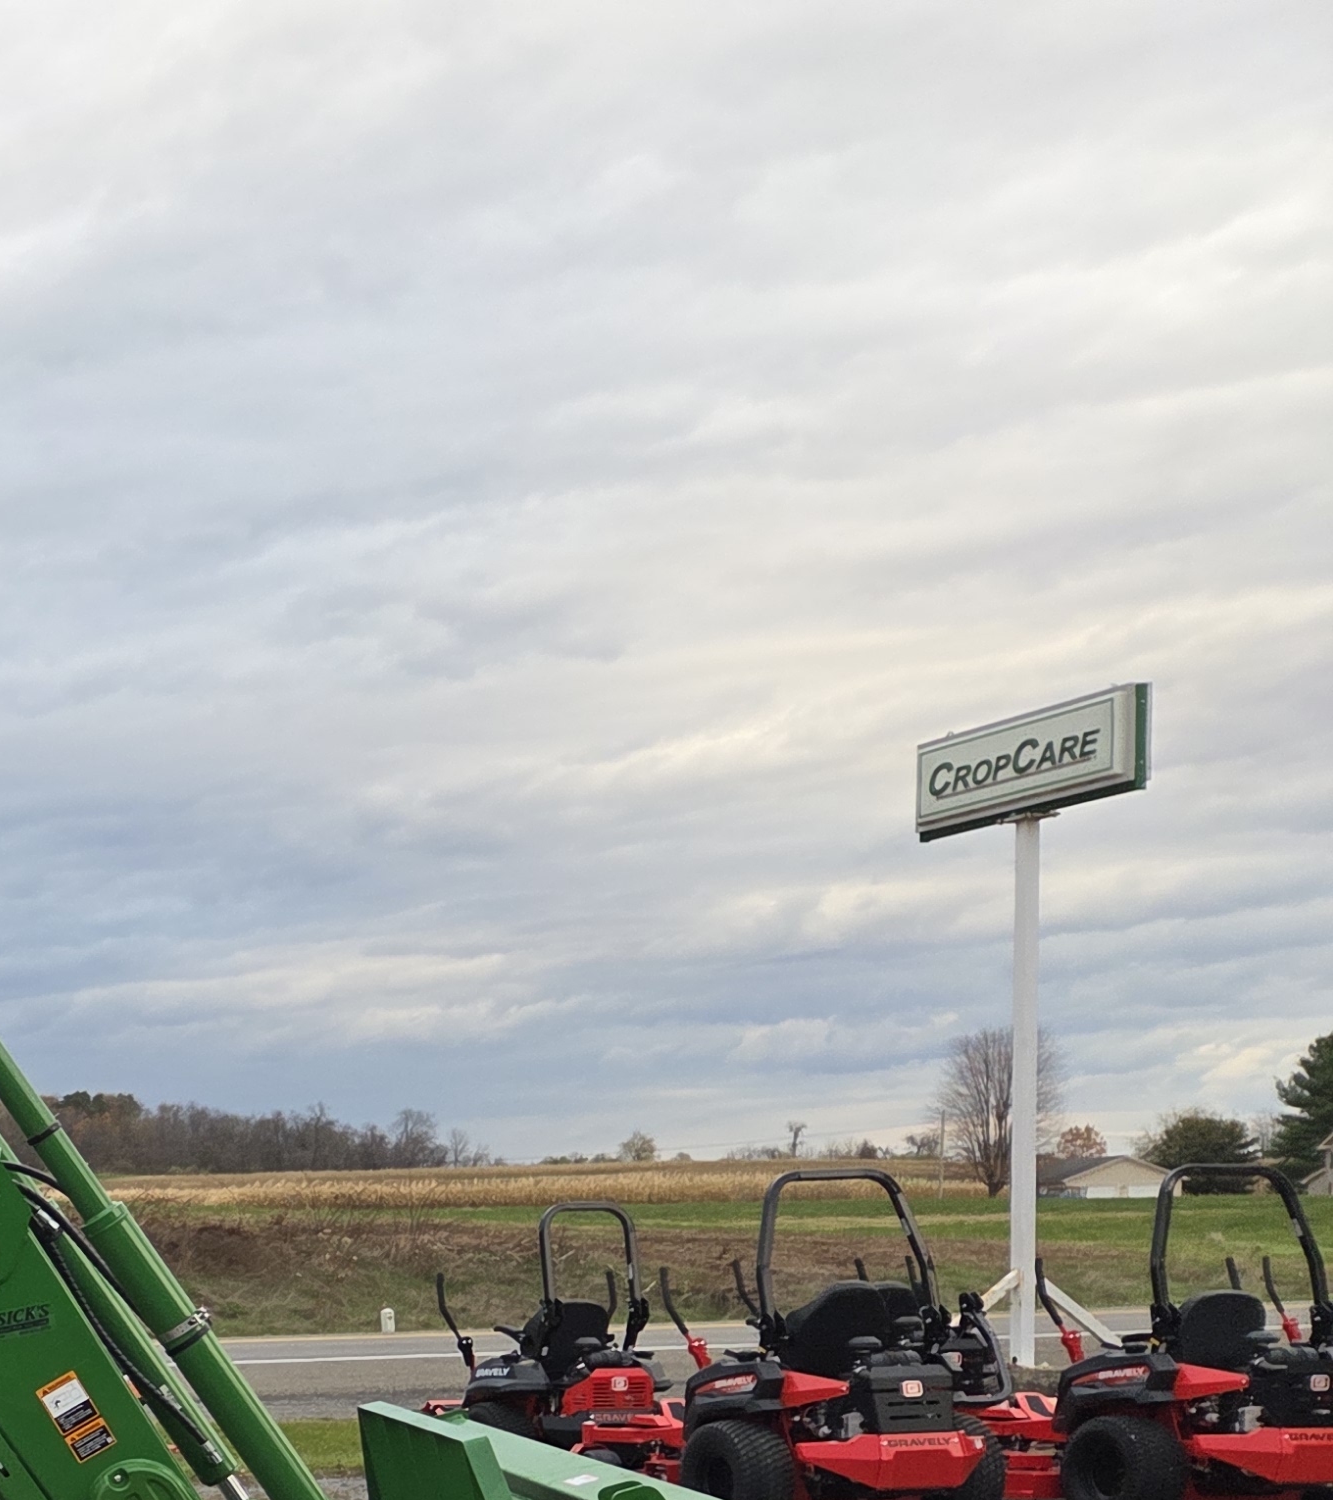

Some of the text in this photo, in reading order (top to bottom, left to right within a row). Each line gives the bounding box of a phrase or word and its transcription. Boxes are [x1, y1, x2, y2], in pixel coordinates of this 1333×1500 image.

[928, 728, 1101, 797] CROPCARE
[887, 1437, 952, 1448] GRAVELY
[1288, 1432, 1333, 1442] GRAVE
